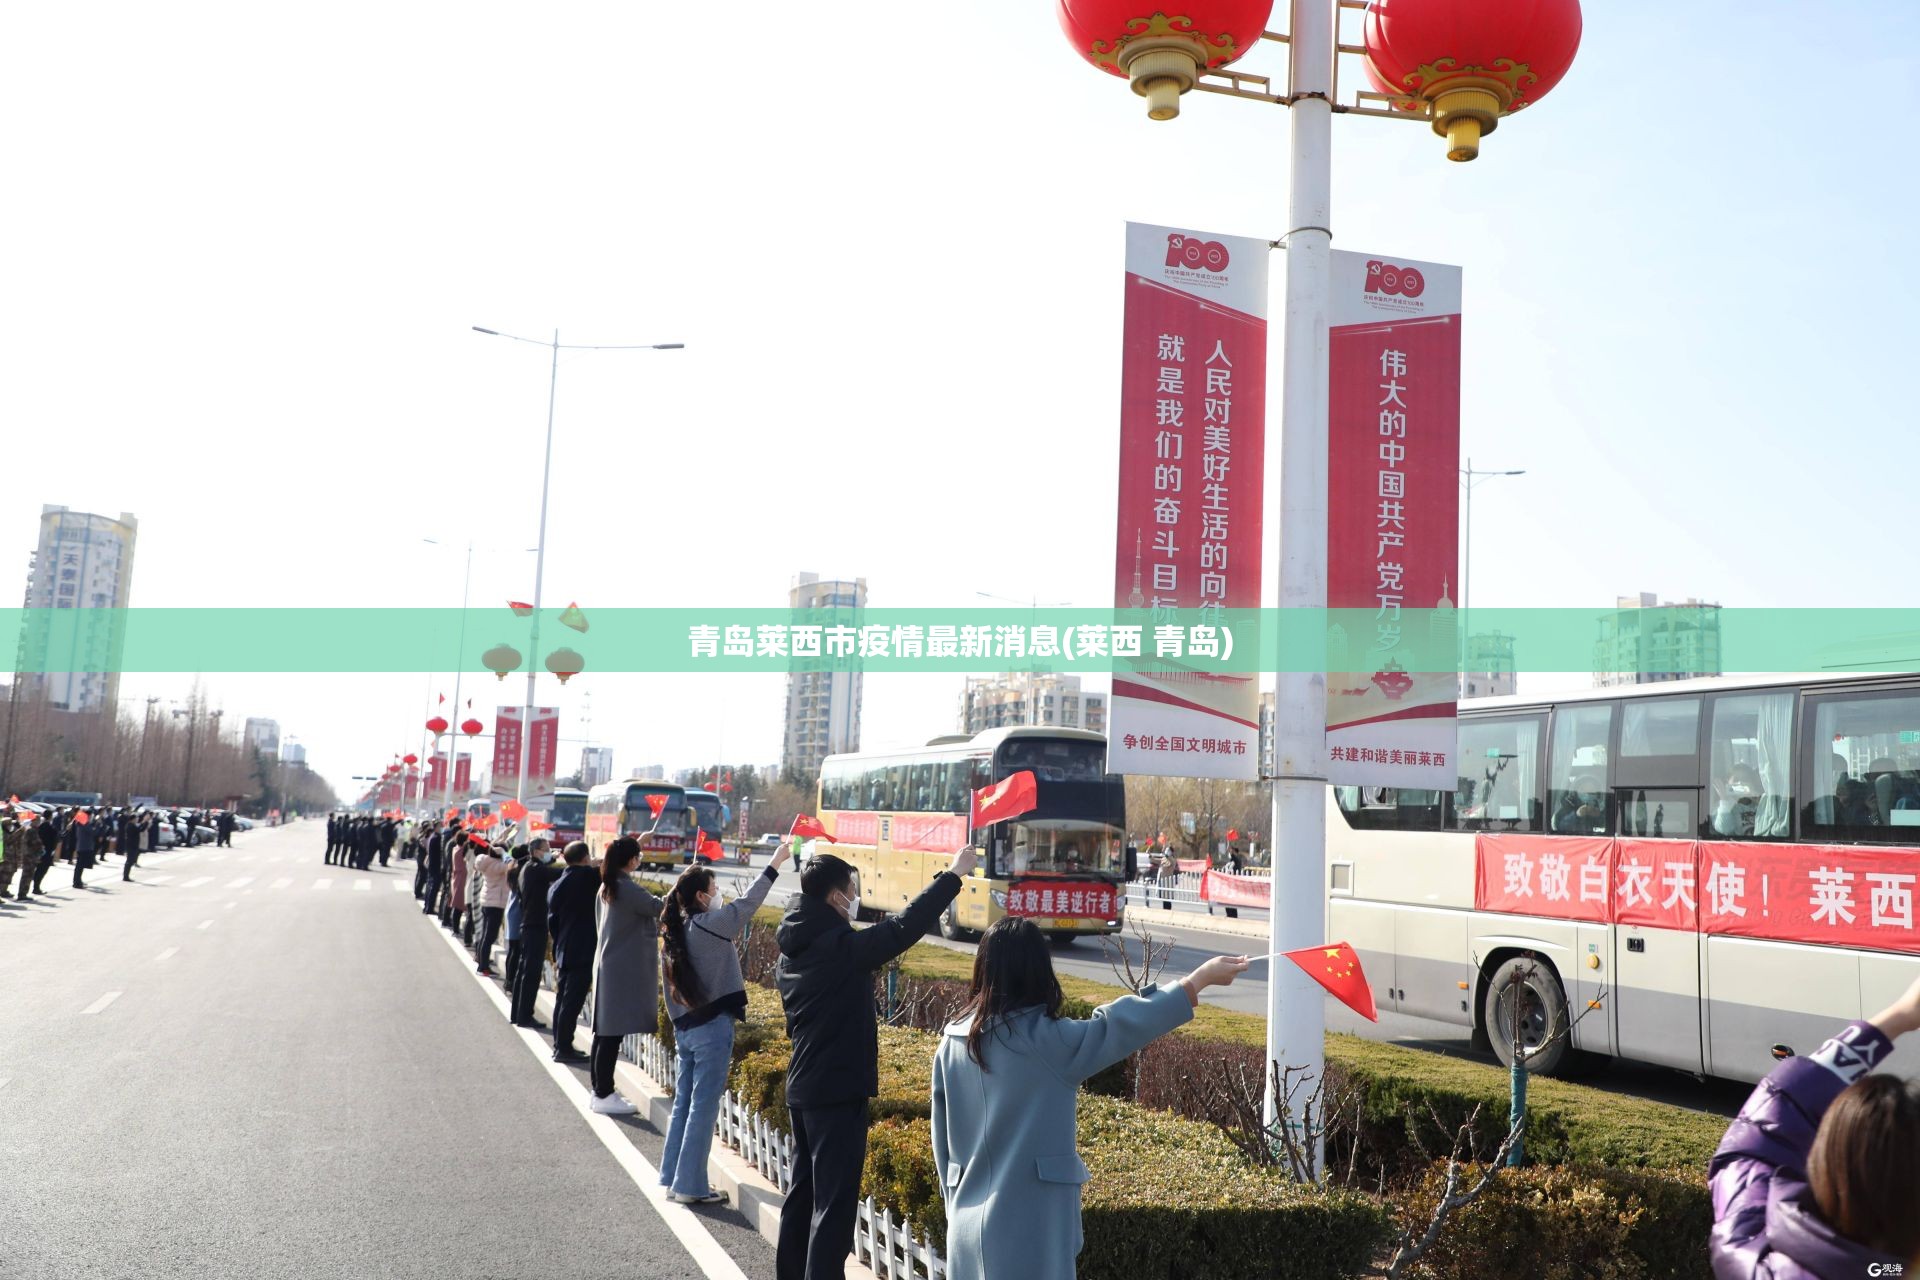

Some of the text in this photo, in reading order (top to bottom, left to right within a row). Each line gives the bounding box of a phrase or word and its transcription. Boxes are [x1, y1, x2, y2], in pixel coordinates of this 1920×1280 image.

[1150, 334, 1185, 624] 就是我们的奋斗目标
[1198, 339, 1233, 628] 人民对美好生活的向往
[1375, 348, 1407, 652] 伟大的中国共产党万岁
[1122, 733, 1247, 756] 争创全国文明城市
[1330, 746, 1446, 767] 共建和谐美丽莱西
